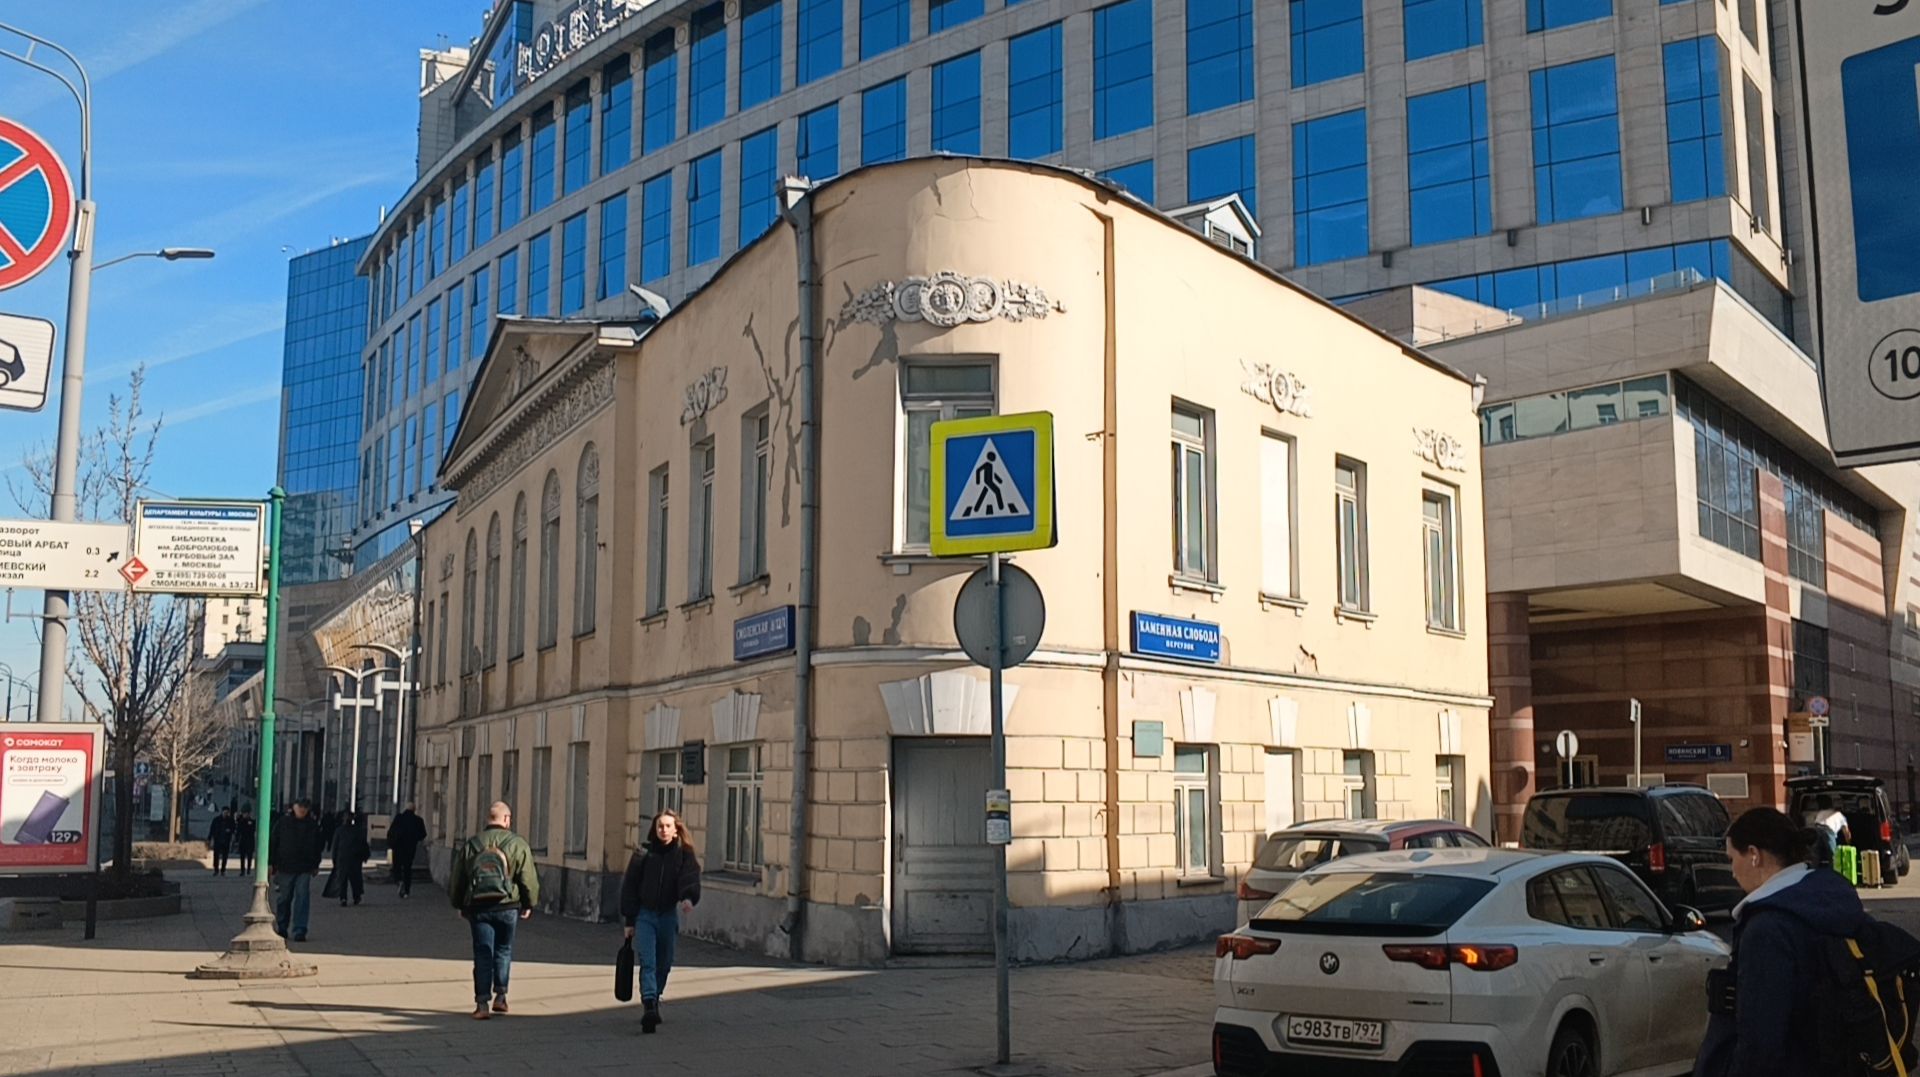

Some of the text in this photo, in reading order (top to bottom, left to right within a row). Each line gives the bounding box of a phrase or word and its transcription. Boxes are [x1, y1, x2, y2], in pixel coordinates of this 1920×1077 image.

[144, 508, 189, 516] ДЕПАРТАМЕНТ
[189, 509, 221, 517] КУЛЬТУРЫ
[228, 510, 257, 518] МОСКВЫ
[171, 535, 227, 543] БИБЛИОТЕКА
[34, 541, 69, 549] АРБАТ
[174, 544, 240, 552] ДОБРОЛЮБОВА
[169, 552, 217, 560] ГЕРБОВЫЙ
[85, 569, 99, 578] 2.2
[229, 581, 254, 589] 13/21
[1140, 620, 1218, 644] КАМЕННАЯ СЛОБОДА
[1166, 640, 1194, 651] ПЕРЕУЛОК
[10, 755, 39, 764] Когда
[17, 765, 62, 773] завтраку
[52, 831, 71, 843] 129
[1355, 1023, 1377, 1036] 797
